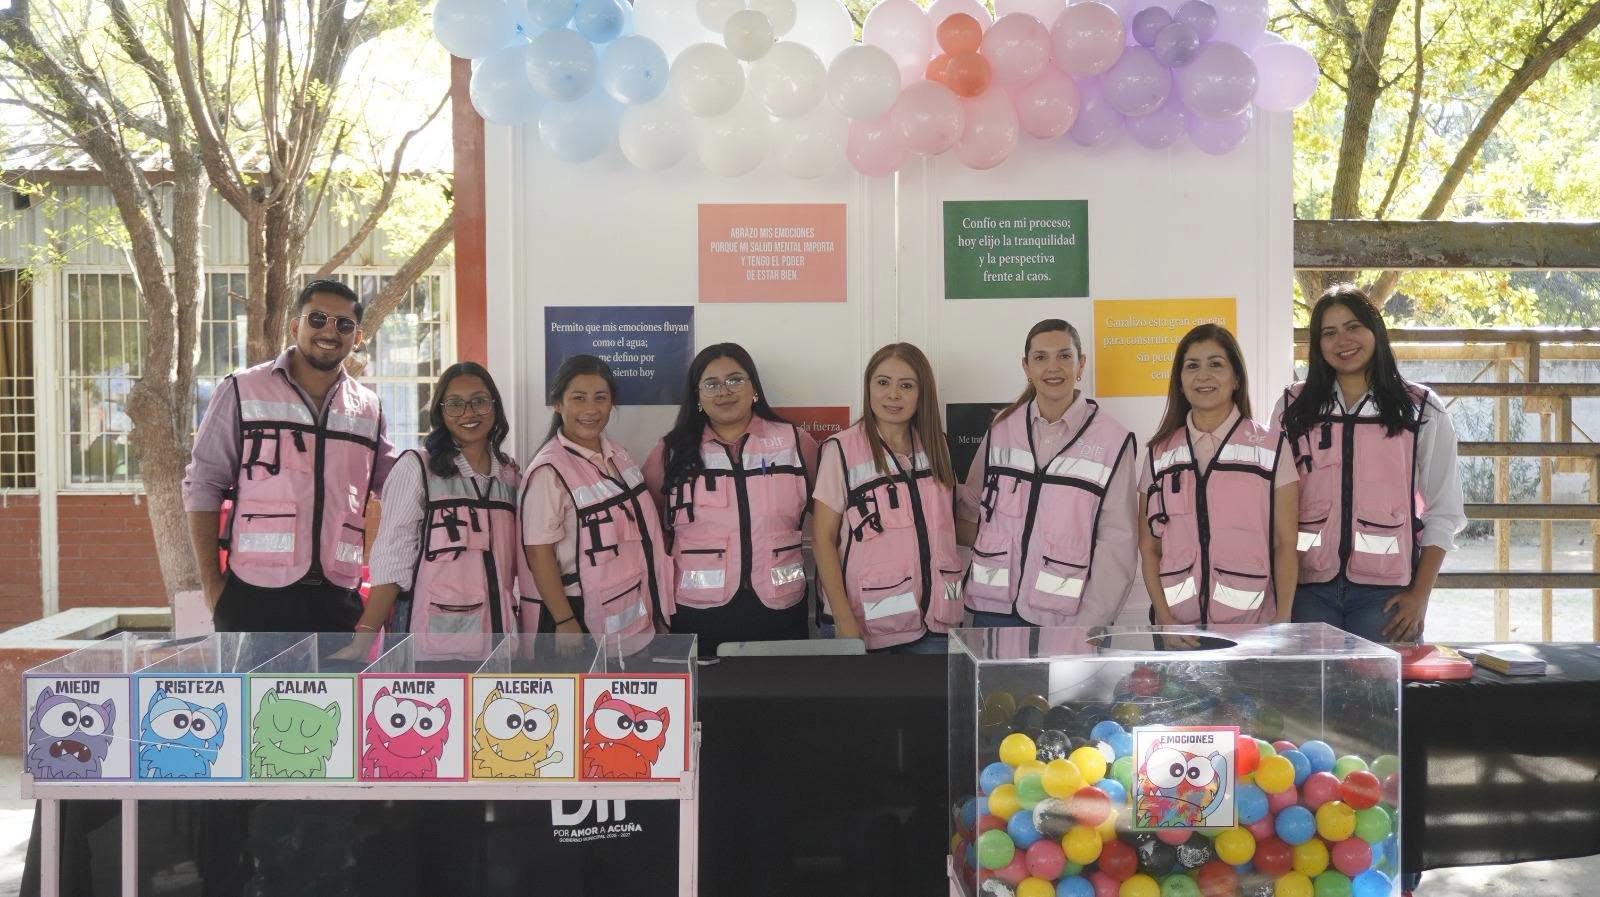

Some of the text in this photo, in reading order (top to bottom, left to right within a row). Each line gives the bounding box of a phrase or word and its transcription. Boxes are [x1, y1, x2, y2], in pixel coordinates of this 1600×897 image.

[962, 216, 1071, 231] Confío en mi proceso;
[730, 227, 815, 239] ABRAZO MIS EMOCIONES
[710, 241, 835, 253] PORQUE MI SALUD MENTAL IMPORTA
[958, 233, 1076, 249] hoy elijo la tranquilidad
[741, 255, 805, 266] Y TENGO EL PODER
[978, 252, 1056, 267] y la perspectiva
[746, 270, 800, 281] DE ESTAR BIEN.
[983, 270, 1052, 282] frente al caos.
[551, 321, 689, 335] Permito que mis emociones fluyan
[1105, 315, 1146, 328] Canalizo
[1169, 317, 1190, 330] gran
[592, 337, 648, 349] como el agua;
[1103, 336, 1125, 347] para
[1126, 334, 1169, 345] construir
[612, 352, 639, 362] defino
[640, 353, 655, 364] por
[1136, 352, 1150, 362] sin
[612, 366, 655, 379] siento hoy
[813, 420, 843, 431] fuerza.
[958, 435, 970, 444] Me
[55, 680, 100, 694] MIEDO
[156, 680, 225, 694] TRISTEZA
[275, 680, 328, 694] CALMA
[392, 680, 435, 694] AMOR
[495, 677, 553, 694] ALEGRÍA
[611, 680, 658, 695] ENOJO
[1160, 735, 1214, 744] EMOCIONES
[553, 822, 642, 838] POR AMOR A ACUÑA
